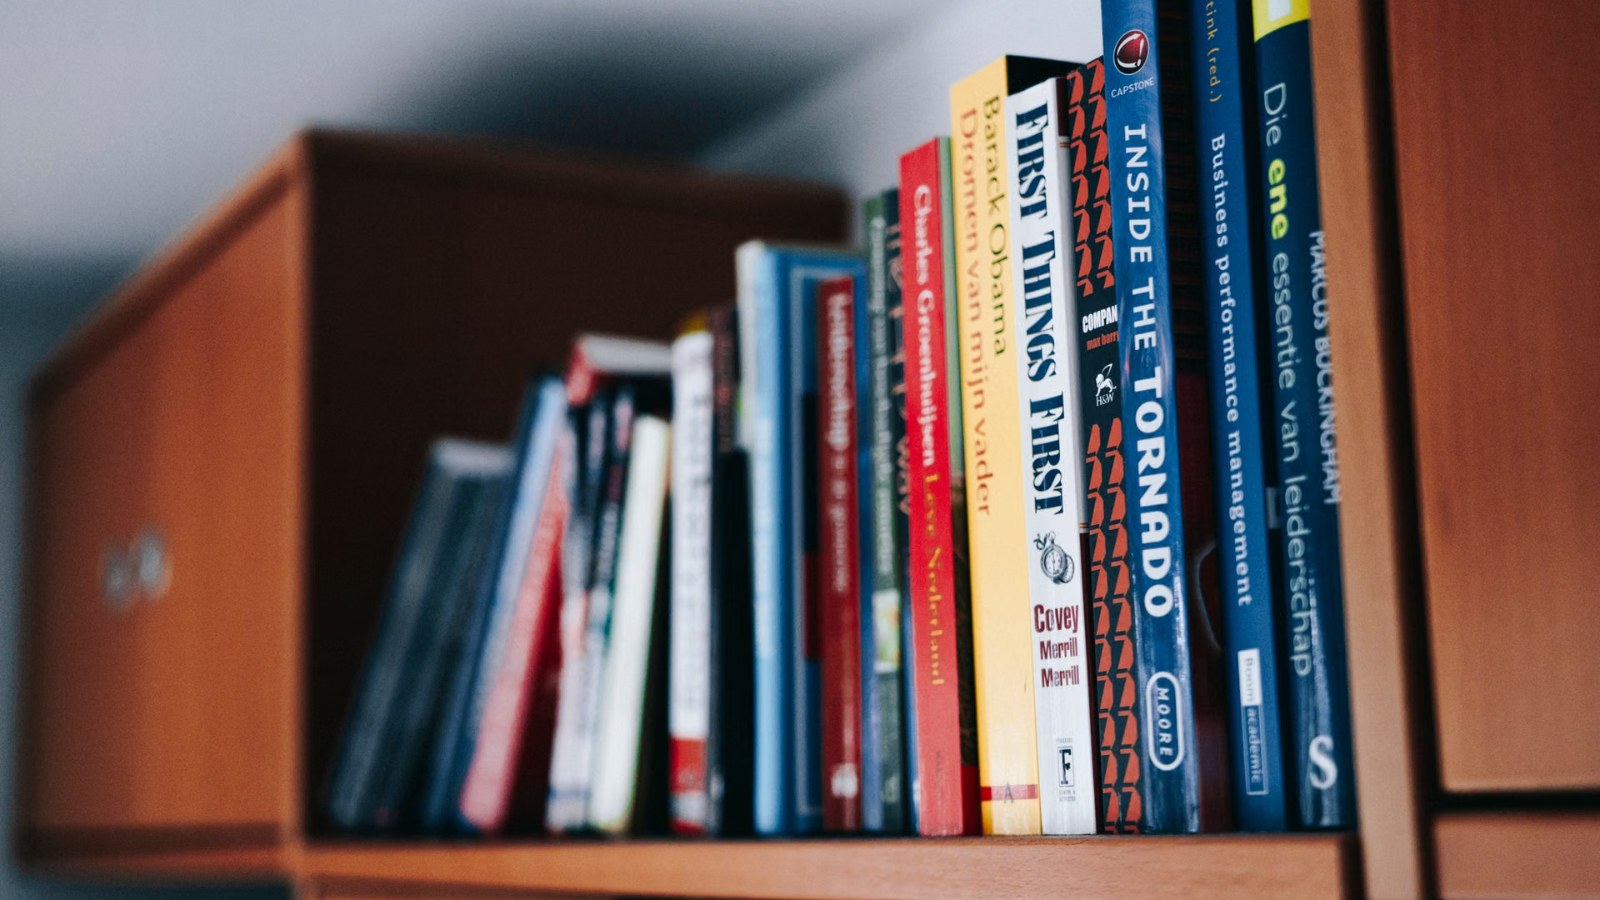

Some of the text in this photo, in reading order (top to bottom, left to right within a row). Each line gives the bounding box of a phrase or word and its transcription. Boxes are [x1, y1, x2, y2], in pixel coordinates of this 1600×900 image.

[1110, 77, 1155, 98] CAPSTONE
[1207, 47, 1224, 104] (red.)
[913, 183, 932, 285] Charles
[983, 95, 1008, 355] Barack Obama
[961, 107, 994, 516] Dromen van mijn vader
[1016, 99, 1064, 515] FIRST THINGS FIRST
[1086, 337, 1101, 350] max
[917, 289, 937, 467] Groenhuijsen
[1124, 123, 1174, 618] INSIDE THE TORNADO
[1211, 133, 1252, 607] Business performance management
[1264, 83, 1314, 677] Die ene essentie van leiderschap
[1309, 230, 1342, 505] MARCUS BUCKINGHAM
[1034, 604, 1079, 633] Covey
[1039, 637, 1078, 660] Merrill
[1041, 665, 1080, 688] Merrill
[1157, 686, 1173, 757] MOORE
[1245, 657, 1262, 784] Boom academic
[1059, 748, 1072, 785] F
[1309, 734, 1338, 790] S
